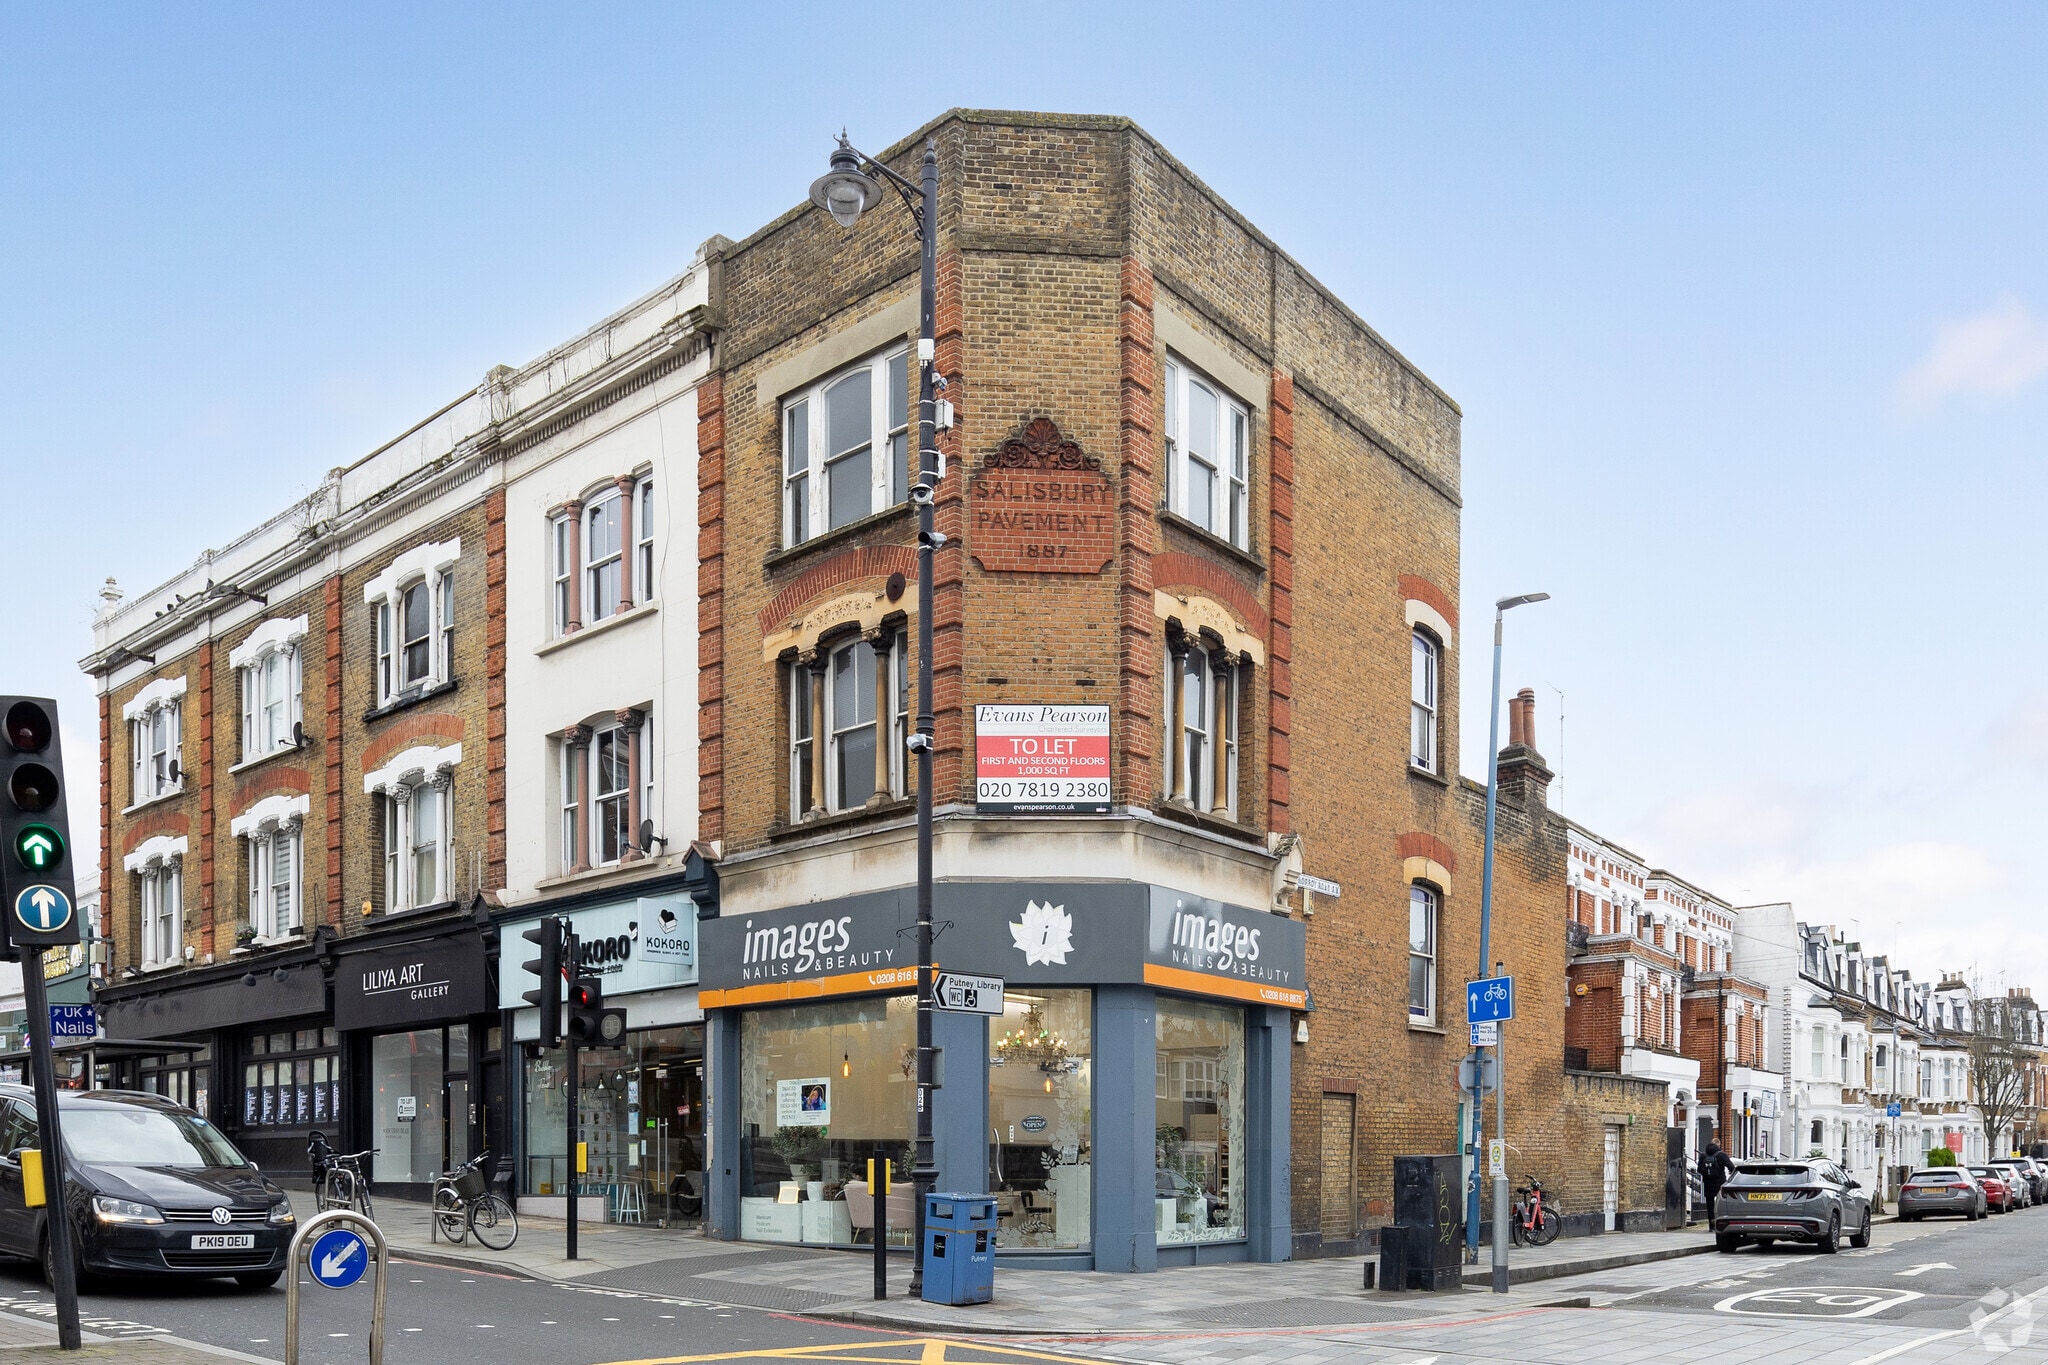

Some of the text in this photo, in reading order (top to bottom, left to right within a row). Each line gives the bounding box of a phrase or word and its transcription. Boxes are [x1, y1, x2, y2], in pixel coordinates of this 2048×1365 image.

[975, 481, 1110, 504] SALISBURY
[978, 511, 1106, 532] PAVEMENT
[1020, 544, 1068, 558] 1887
[978, 706, 1108, 722] Evans Pearson
[1038, 725, 1107, 734] Chartered Surveyors
[1009, 738, 1077, 755] TO LET
[982, 757, 1105, 765] FIRST AND SECOND FLOORS
[1018, 767, 1070, 775] 1,000 SQ FT
[979, 783, 1108, 797] 020 7819 2380
[1013, 803, 1075, 811] evanspearson.co.uk
[1172, 899, 1261, 970] images
[646, 936, 690, 951] KOKORO
[743, 918, 851, 973] images
[1172, 949, 1213, 969] NAILS
[363, 963, 424, 990] LILIYA ART
[743, 962, 789, 980] NAILS
[876, 973, 895, 984] 0208
[897, 971, 912, 982] 616
[949, 977, 1002, 991] Putney Library
[411, 985, 449, 1000] GALLERY
[951, 991, 961, 1002] WC
[64, 1008, 83, 1018] UK
[55, 1021, 94, 1034] Nails
[199, 1236, 248, 1247] PK19 OEU
[971, 1255, 988, 1263] Putney
